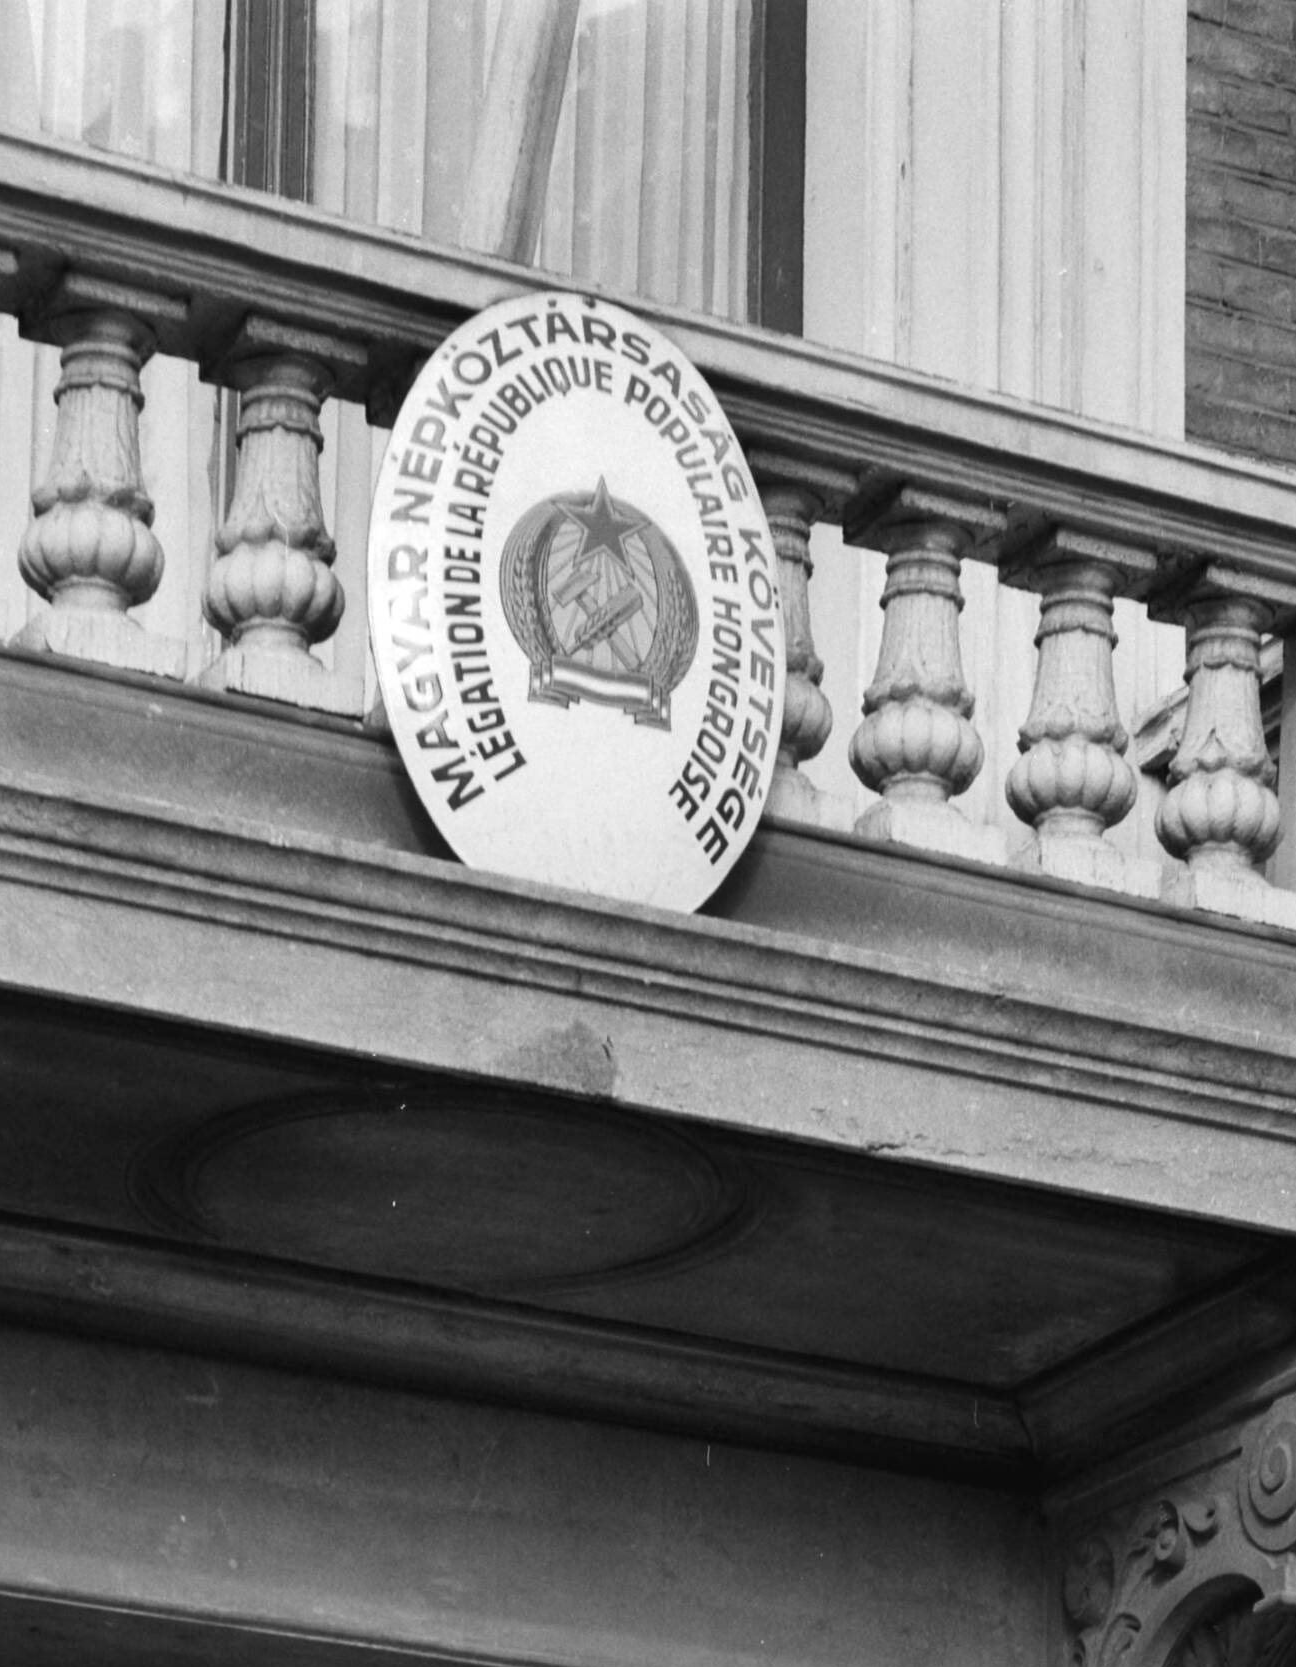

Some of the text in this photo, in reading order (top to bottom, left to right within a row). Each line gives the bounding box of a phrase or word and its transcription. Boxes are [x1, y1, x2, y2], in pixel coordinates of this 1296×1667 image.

[388, 545, 485, 811] MAGYAR
[696, 528, 780, 865] KÖVETSÉGE
[444, 355, 742, 822] LÉGATION DE LA RÉPUBLIQUE POPULAIRE HONGROISE
